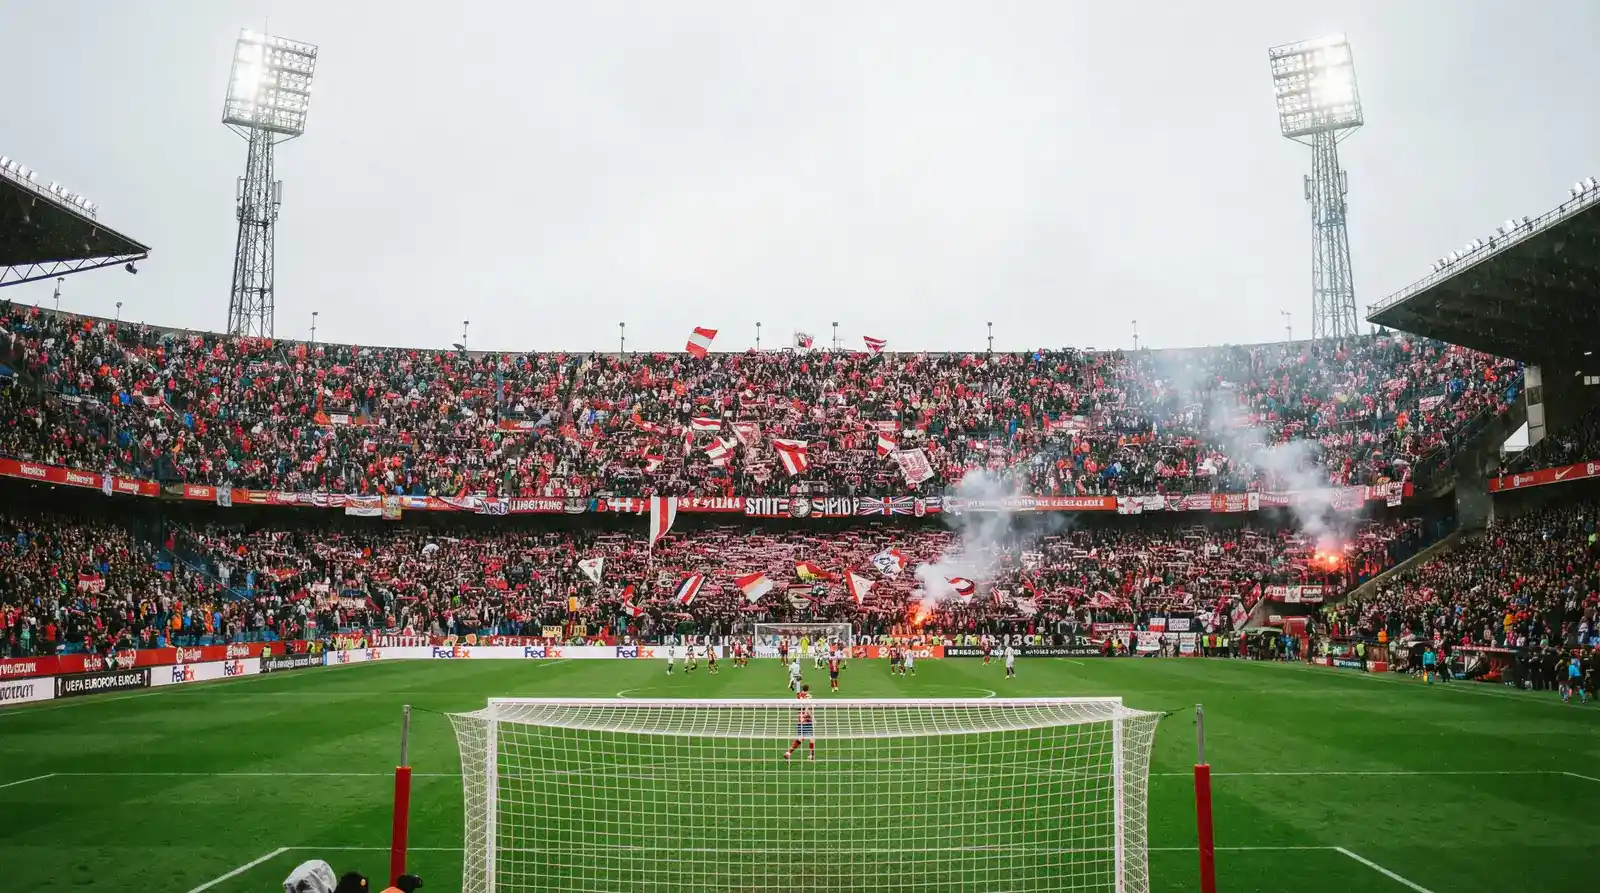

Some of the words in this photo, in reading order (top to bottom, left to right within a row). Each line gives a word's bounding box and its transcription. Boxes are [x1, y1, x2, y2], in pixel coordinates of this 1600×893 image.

[433, 646, 470, 658] FedEx
[525, 646, 562, 659] FedEx
[616, 646, 655, 659] FedEx
[172, 664, 195, 682] FedEx
[65, 680, 84, 692] UEFA
